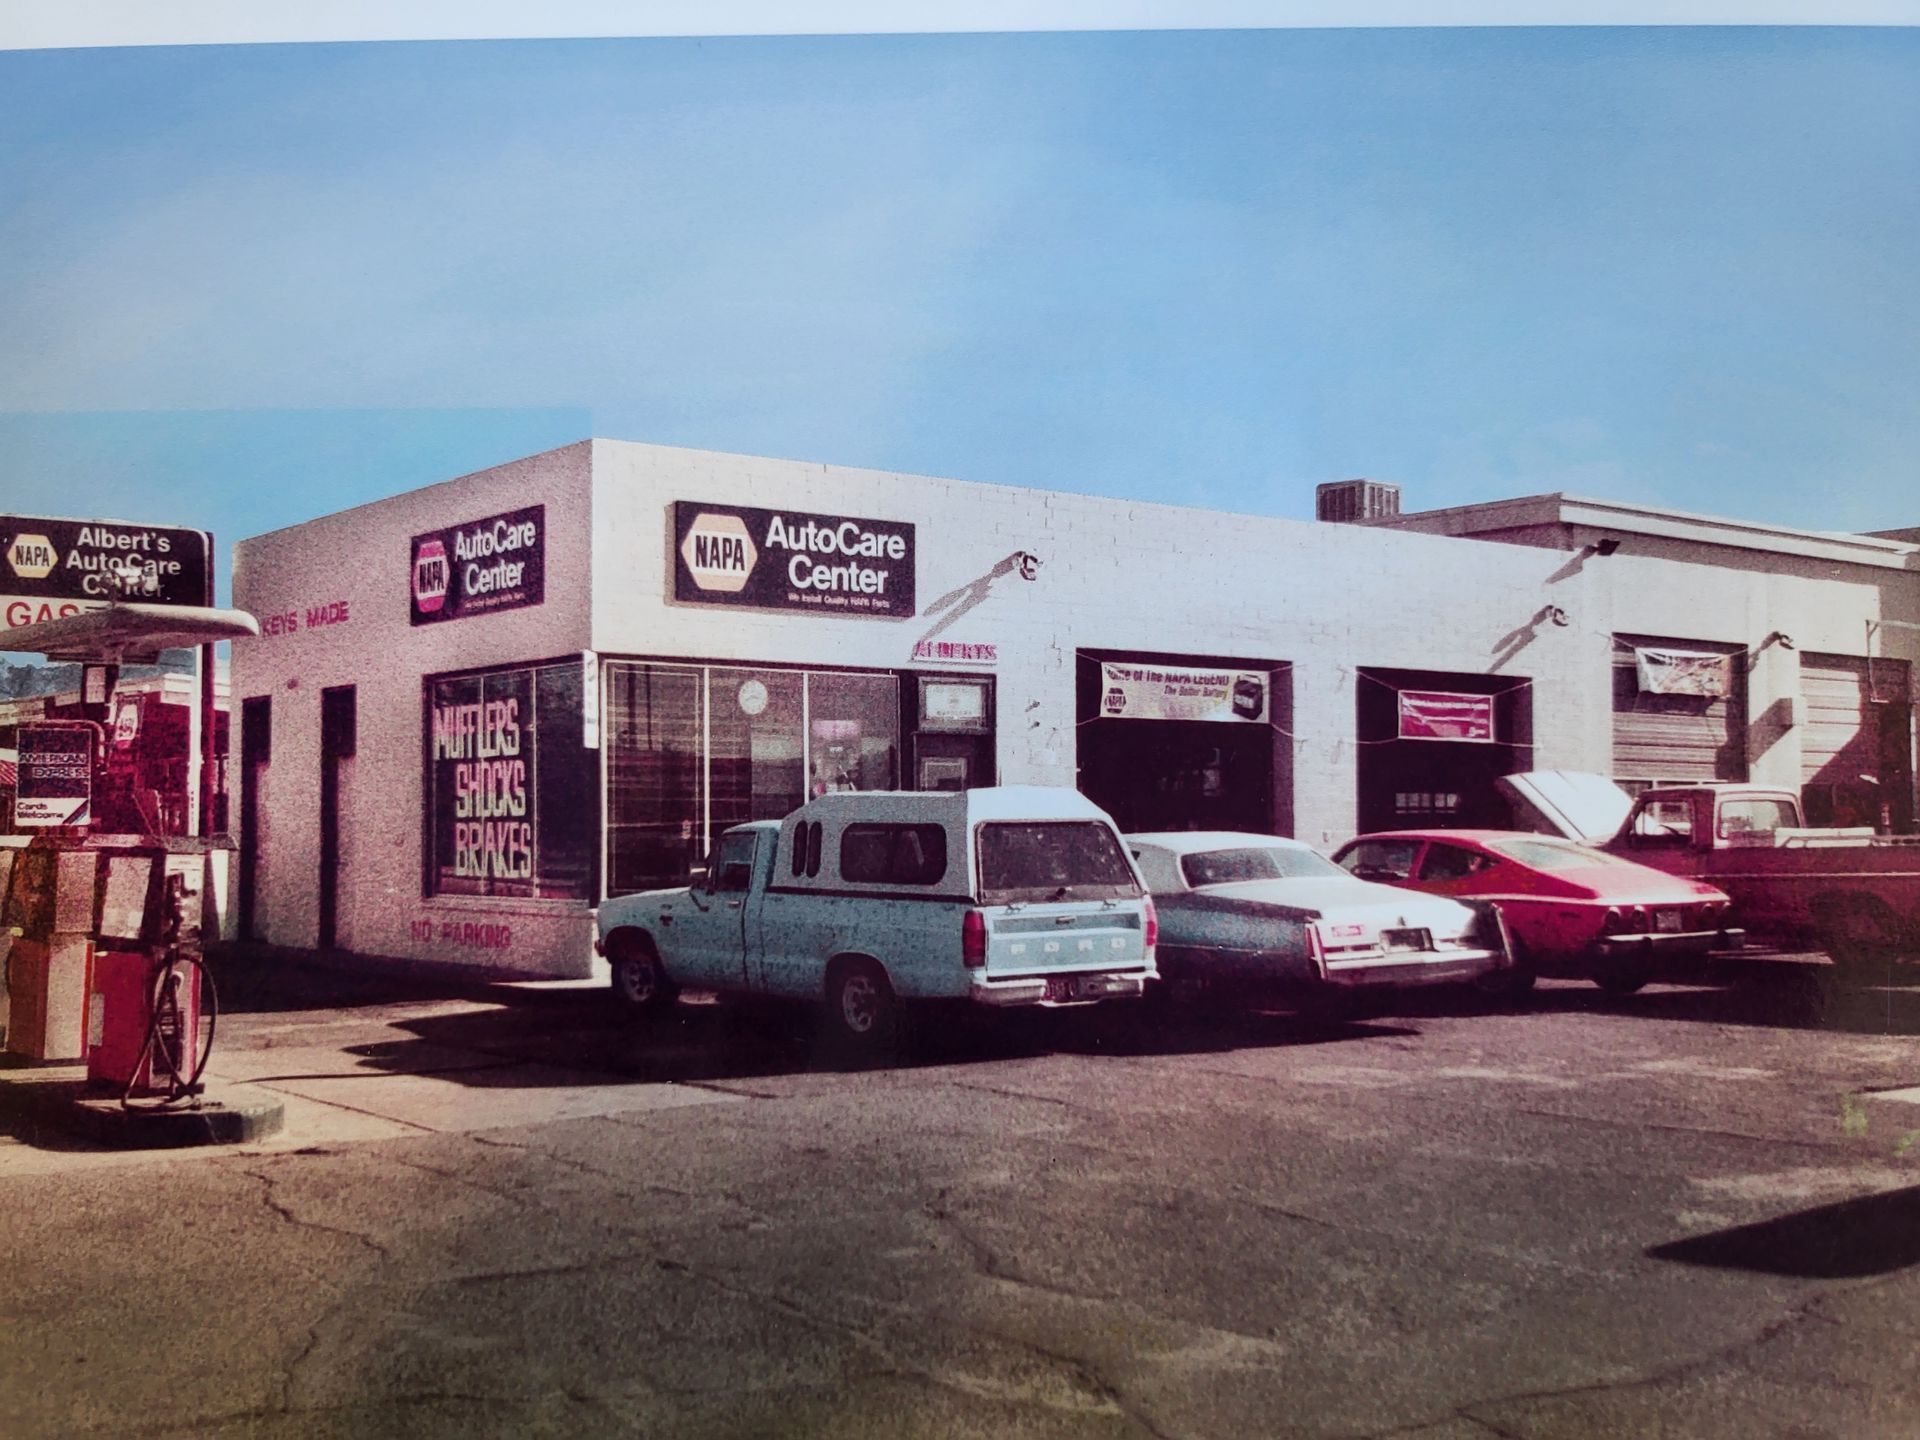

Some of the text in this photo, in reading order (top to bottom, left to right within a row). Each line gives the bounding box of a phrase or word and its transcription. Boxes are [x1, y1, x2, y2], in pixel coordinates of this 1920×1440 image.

[77, 526, 171, 553] Albert's
[455, 520, 536, 561] AutoCare
[765, 515, 906, 559] AutoCare
[15, 545, 50, 567] NAPA
[66, 549, 182, 575] AutoCare
[694, 535, 746, 571] NAPA
[419, 560, 445, 593] NAPA
[466, 558, 525, 595] Center
[788, 555, 889, 593] Center
[6, 601, 80, 628] GAS
[262, 601, 349, 637] KEYS MADE
[1164, 674, 1191, 684] NAPA
[432, 698, 520, 761] MUFFLERS
[19, 752, 88, 765] AMERICAN
[34, 766, 91, 779] EXPRESS
[456, 760, 526, 818] SHOCKS
[17, 802, 49, 811] Cards
[17, 810, 65, 819] Welcome
[455, 822, 532, 878] BRAKES
[410, 920, 511, 948] NO PARKING
